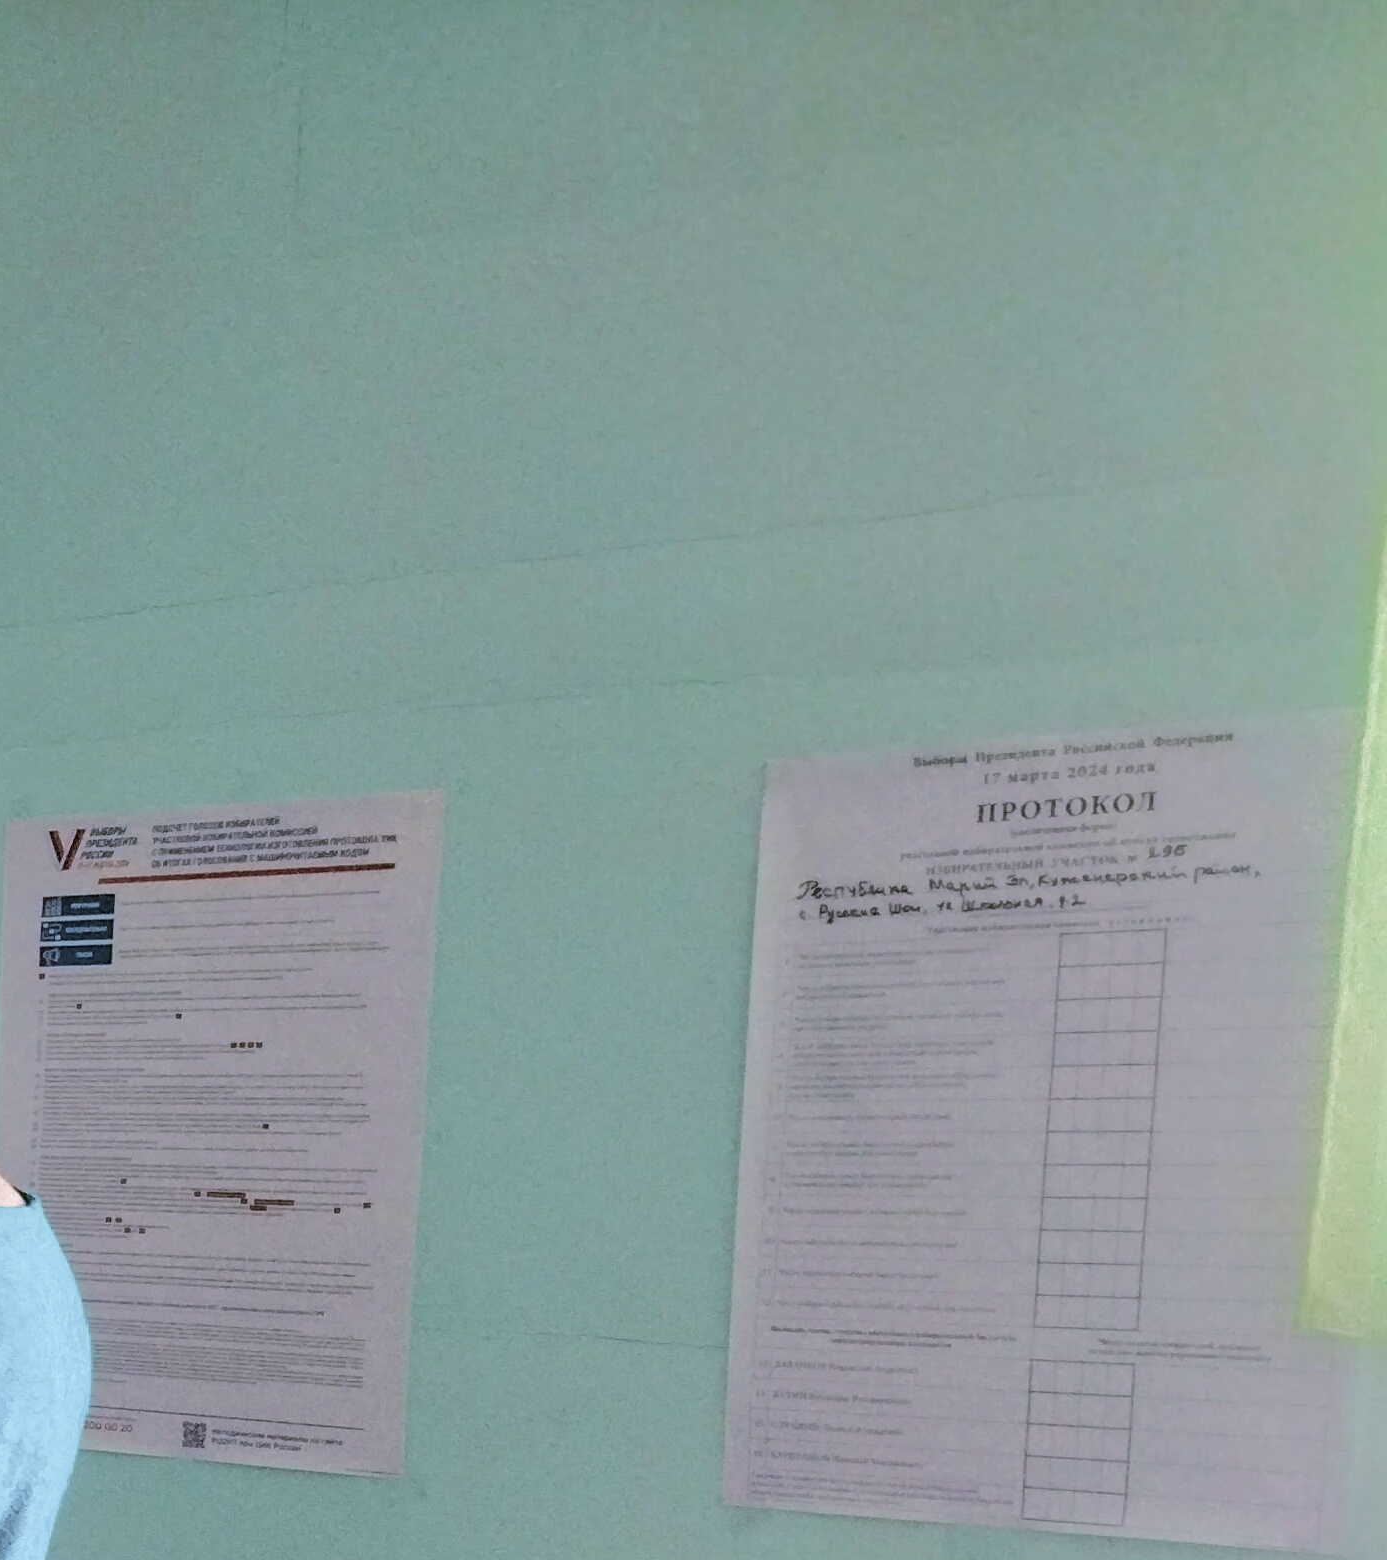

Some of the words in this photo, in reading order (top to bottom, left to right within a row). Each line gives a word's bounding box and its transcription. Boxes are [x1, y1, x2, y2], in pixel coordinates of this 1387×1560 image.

[1008, 770, 1060, 785] марта
[1067, 765, 1108, 779] 2024
[1115, 762, 1157, 776] года
[976, 790, 1158, 824] ПРОТОКОЛ
